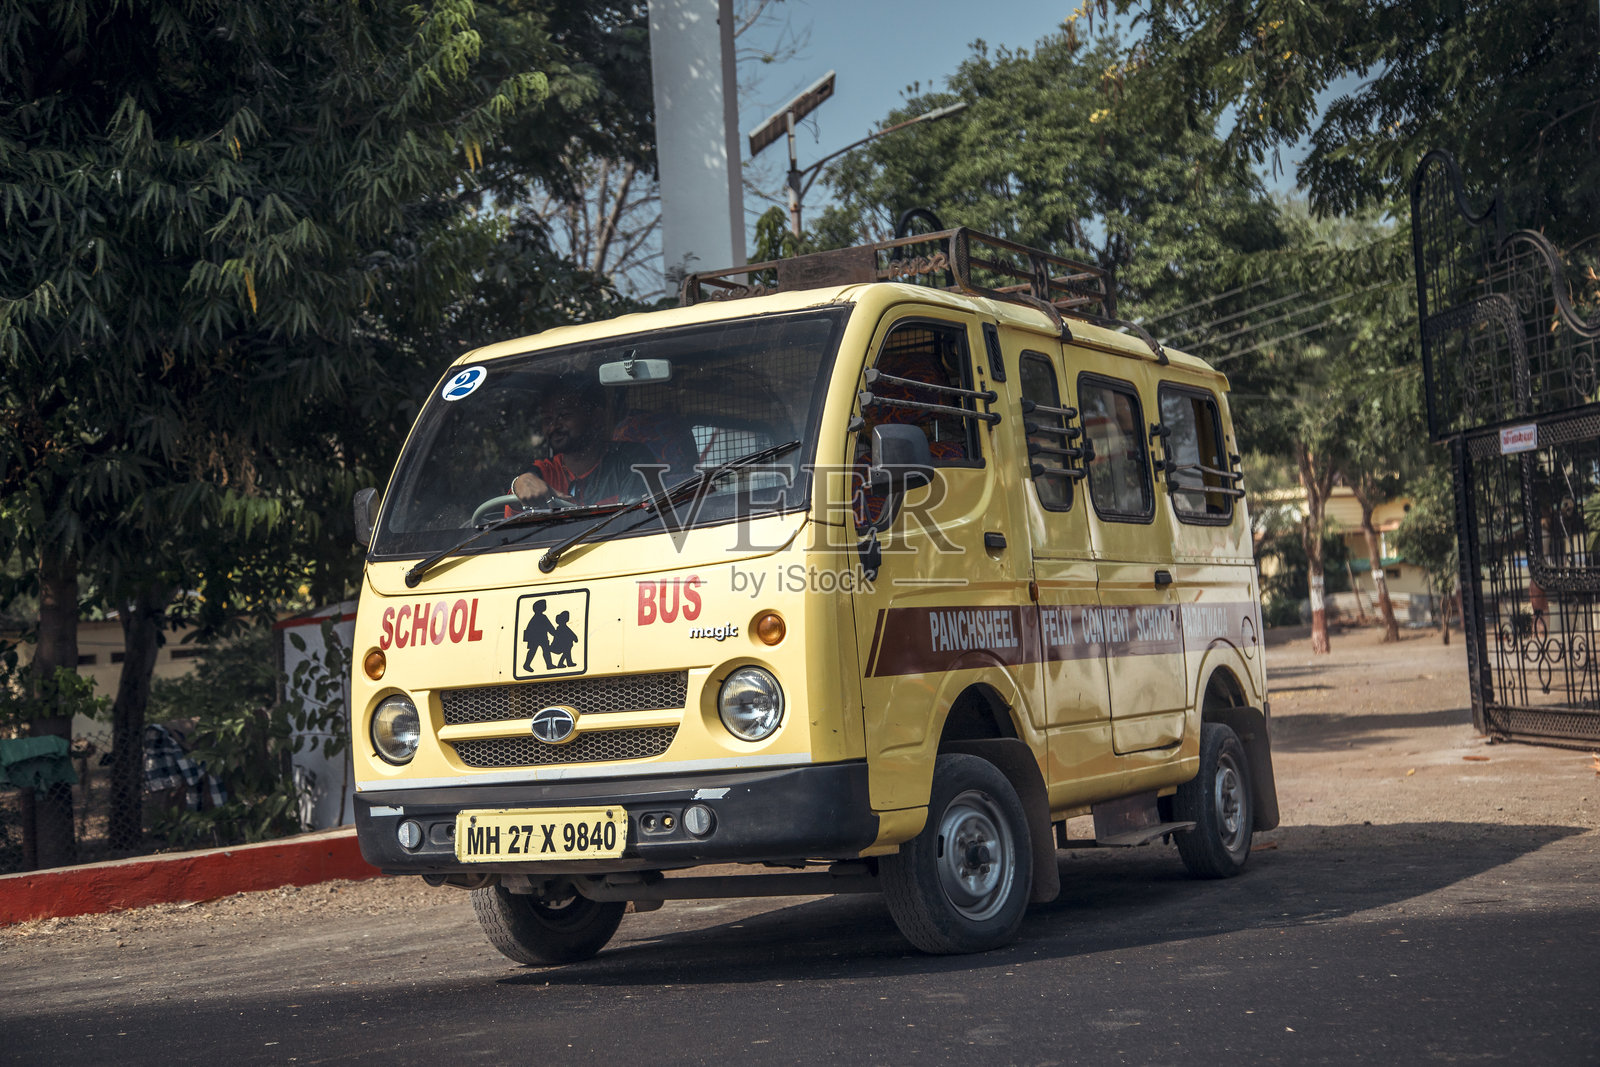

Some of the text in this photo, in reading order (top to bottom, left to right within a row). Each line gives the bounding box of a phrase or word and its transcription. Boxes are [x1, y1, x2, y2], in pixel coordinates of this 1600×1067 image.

[446, 369, 481, 397] 2
[380, 574, 702, 650] SCHOOL BUS
[929, 610, 1018, 652] PANCHSHEEL
[1041, 609, 1076, 647] FELIX
[1081, 608, 1131, 644] CONVENT
[1135, 607, 1175, 641] SCHOOL
[689, 621, 739, 642] magic
[467, 820, 616, 855] MH 27 X 9840
